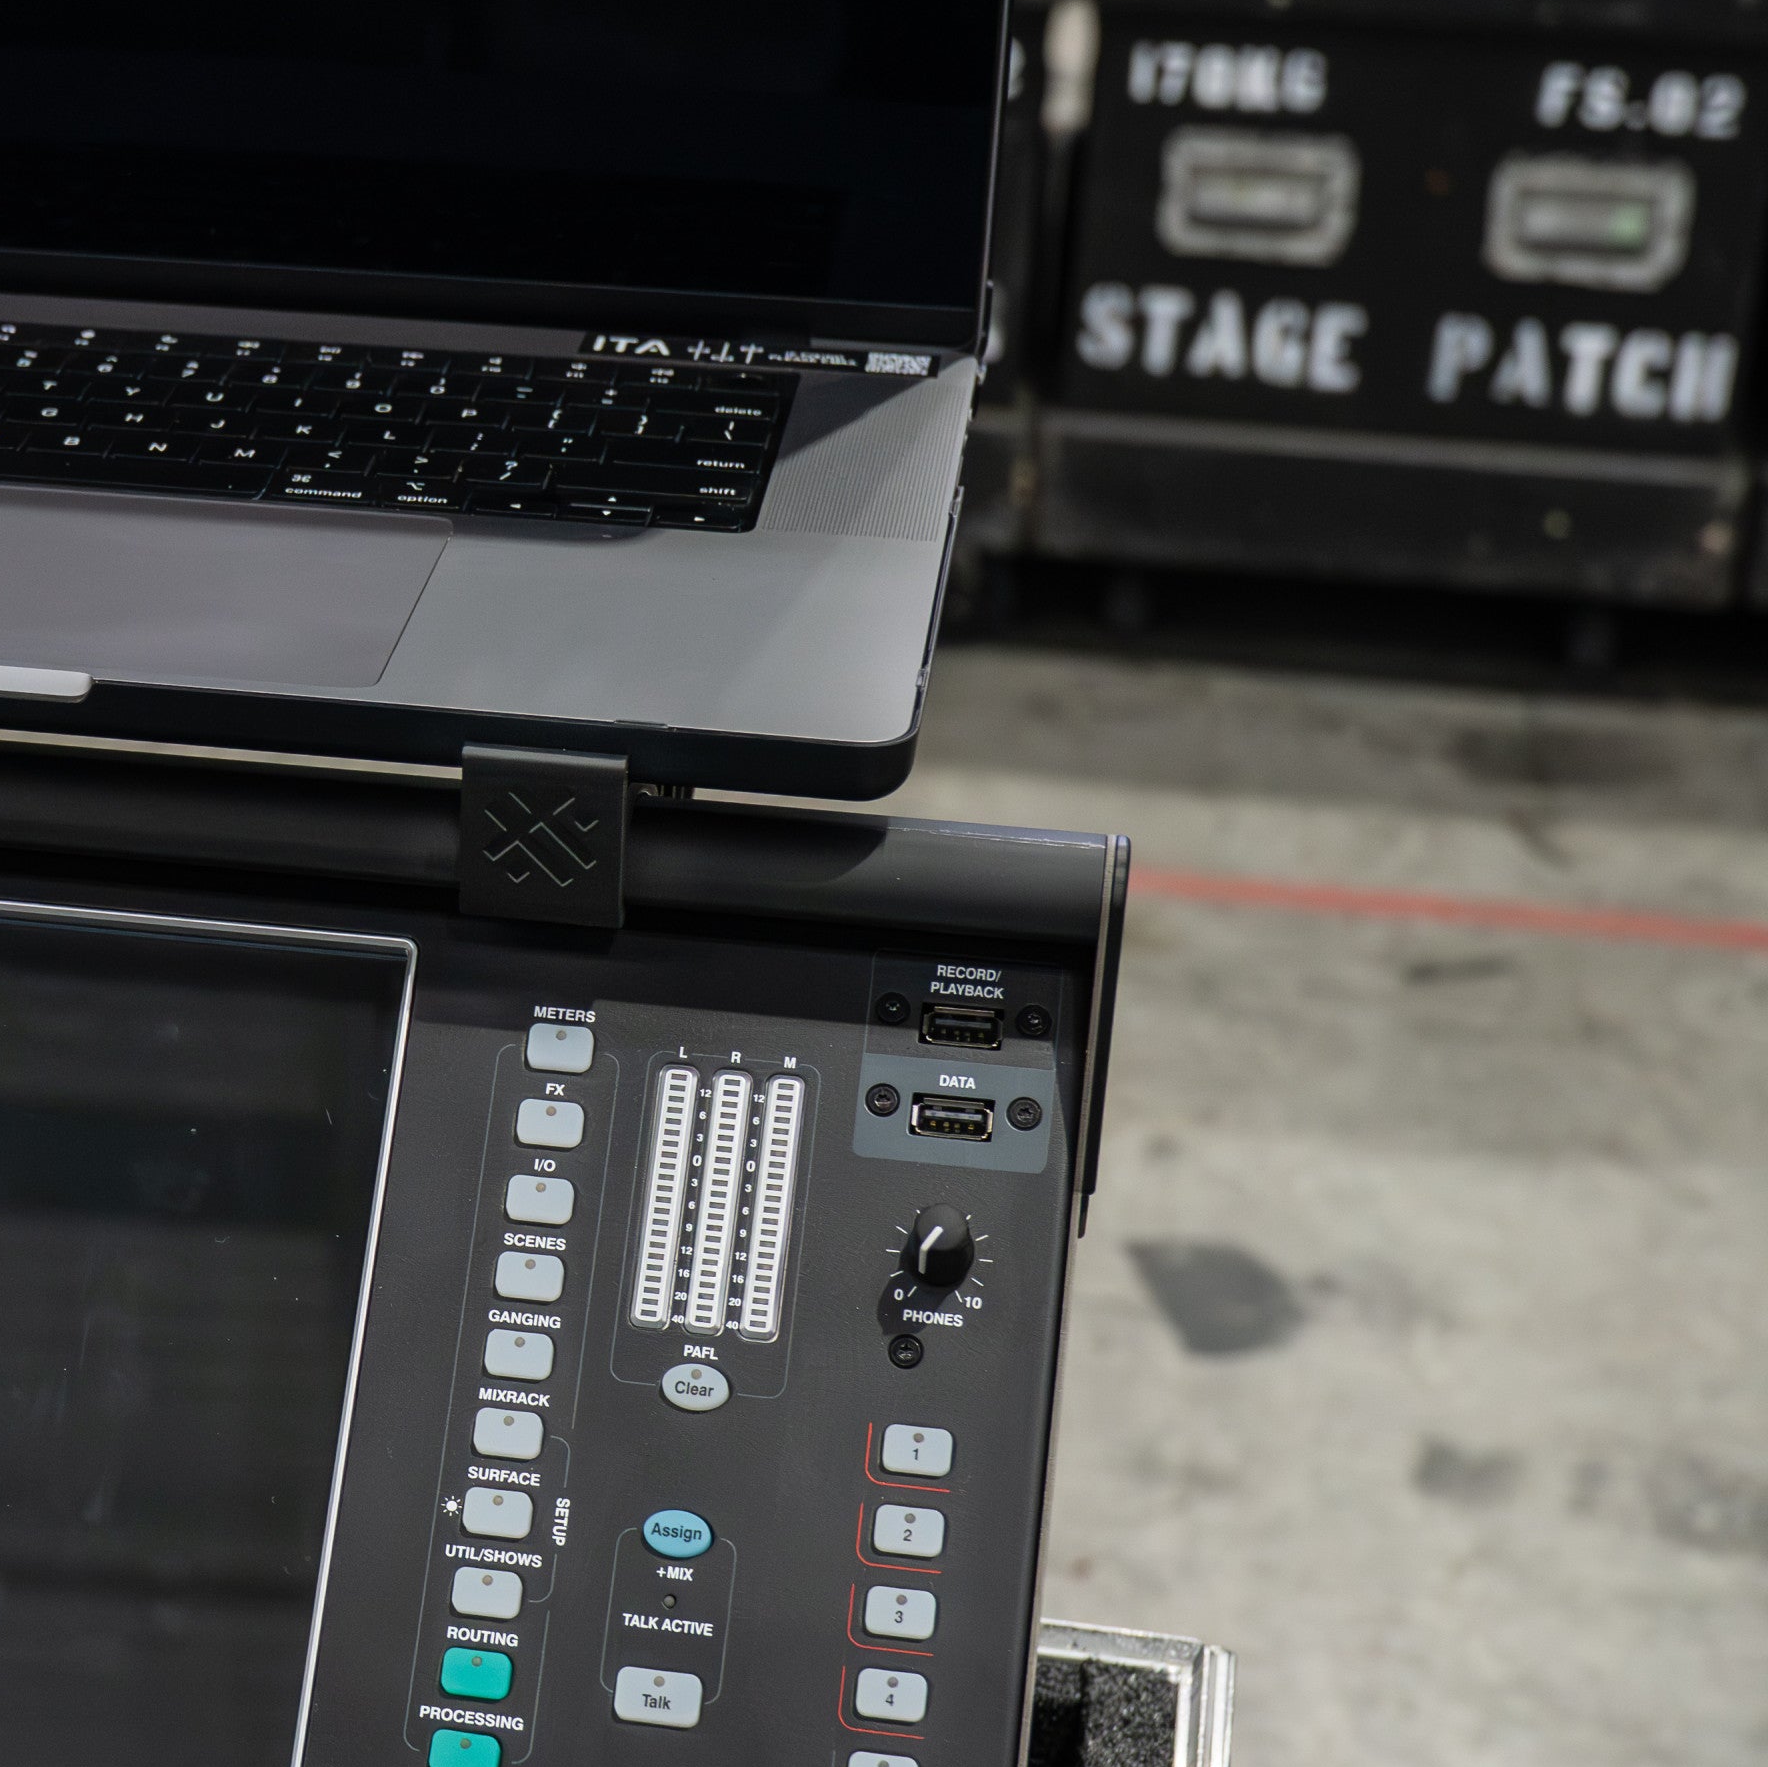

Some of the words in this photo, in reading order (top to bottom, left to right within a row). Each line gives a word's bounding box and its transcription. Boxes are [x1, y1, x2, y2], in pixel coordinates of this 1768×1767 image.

[594, 336, 669, 355] ITA
[1078, 287, 1363, 393] STAGE
[1430, 317, 1735, 421] PATCH
[697, 460, 744, 468] return
[286, 489, 361, 497] command
[933, 965, 1001, 987] RECORD/
[931, 982, 1003, 998] PLAYBACK
[534, 1006, 595, 1022] METERS
[680, 1047, 687, 1058] L
[731, 1052, 741, 1063] R
[784, 1057, 796, 1068] M
[940, 1075, 975, 1089] DATA
[546, 1083, 565, 1095] FX
[700, 1089, 711, 1097] 12
[699, 1111, 706, 1119] 6
[534, 1159, 555, 1171] I/O
[693, 1155, 702, 1166] 0
[689, 1201, 695, 1209] 6
[504, 1233, 566, 1250] SCENES
[681, 1246, 692, 1255] 12
[678, 1269, 689, 1277] 16
[675, 1292, 687, 1300] 20
[894, 1289, 903, 1300] 0
[964, 1297, 982, 1309] 10
[489, 1310, 561, 1328] GANGING
[672, 1315, 684, 1323] 40
[903, 1310, 963, 1327] PHONES
[684, 1345, 718, 1360] PAFL
[675, 1381, 714, 1396] Clear
[479, 1388, 550, 1407] MIXRACK
[913, 1449, 918, 1460] 1
[468, 1466, 540, 1486] SURFACE
[552, 1498, 570, 1546] SETUP
[651, 1523, 701, 1542] Assign
[903, 1529, 912, 1541] 2
[446, 1544, 542, 1567] UTIL/SHOWS
[657, 1566, 693, 1581] +MIX
[895, 1611, 903, 1623] 3
[623, 1613, 668, 1630] TALK
[664, 1619, 713, 1636] ACTIVE
[447, 1626, 518, 1646] ROUTING
[643, 1694, 670, 1709] Talk
[886, 1694, 893, 1705] 4
[420, 1706, 523, 1730] PROCESSING
